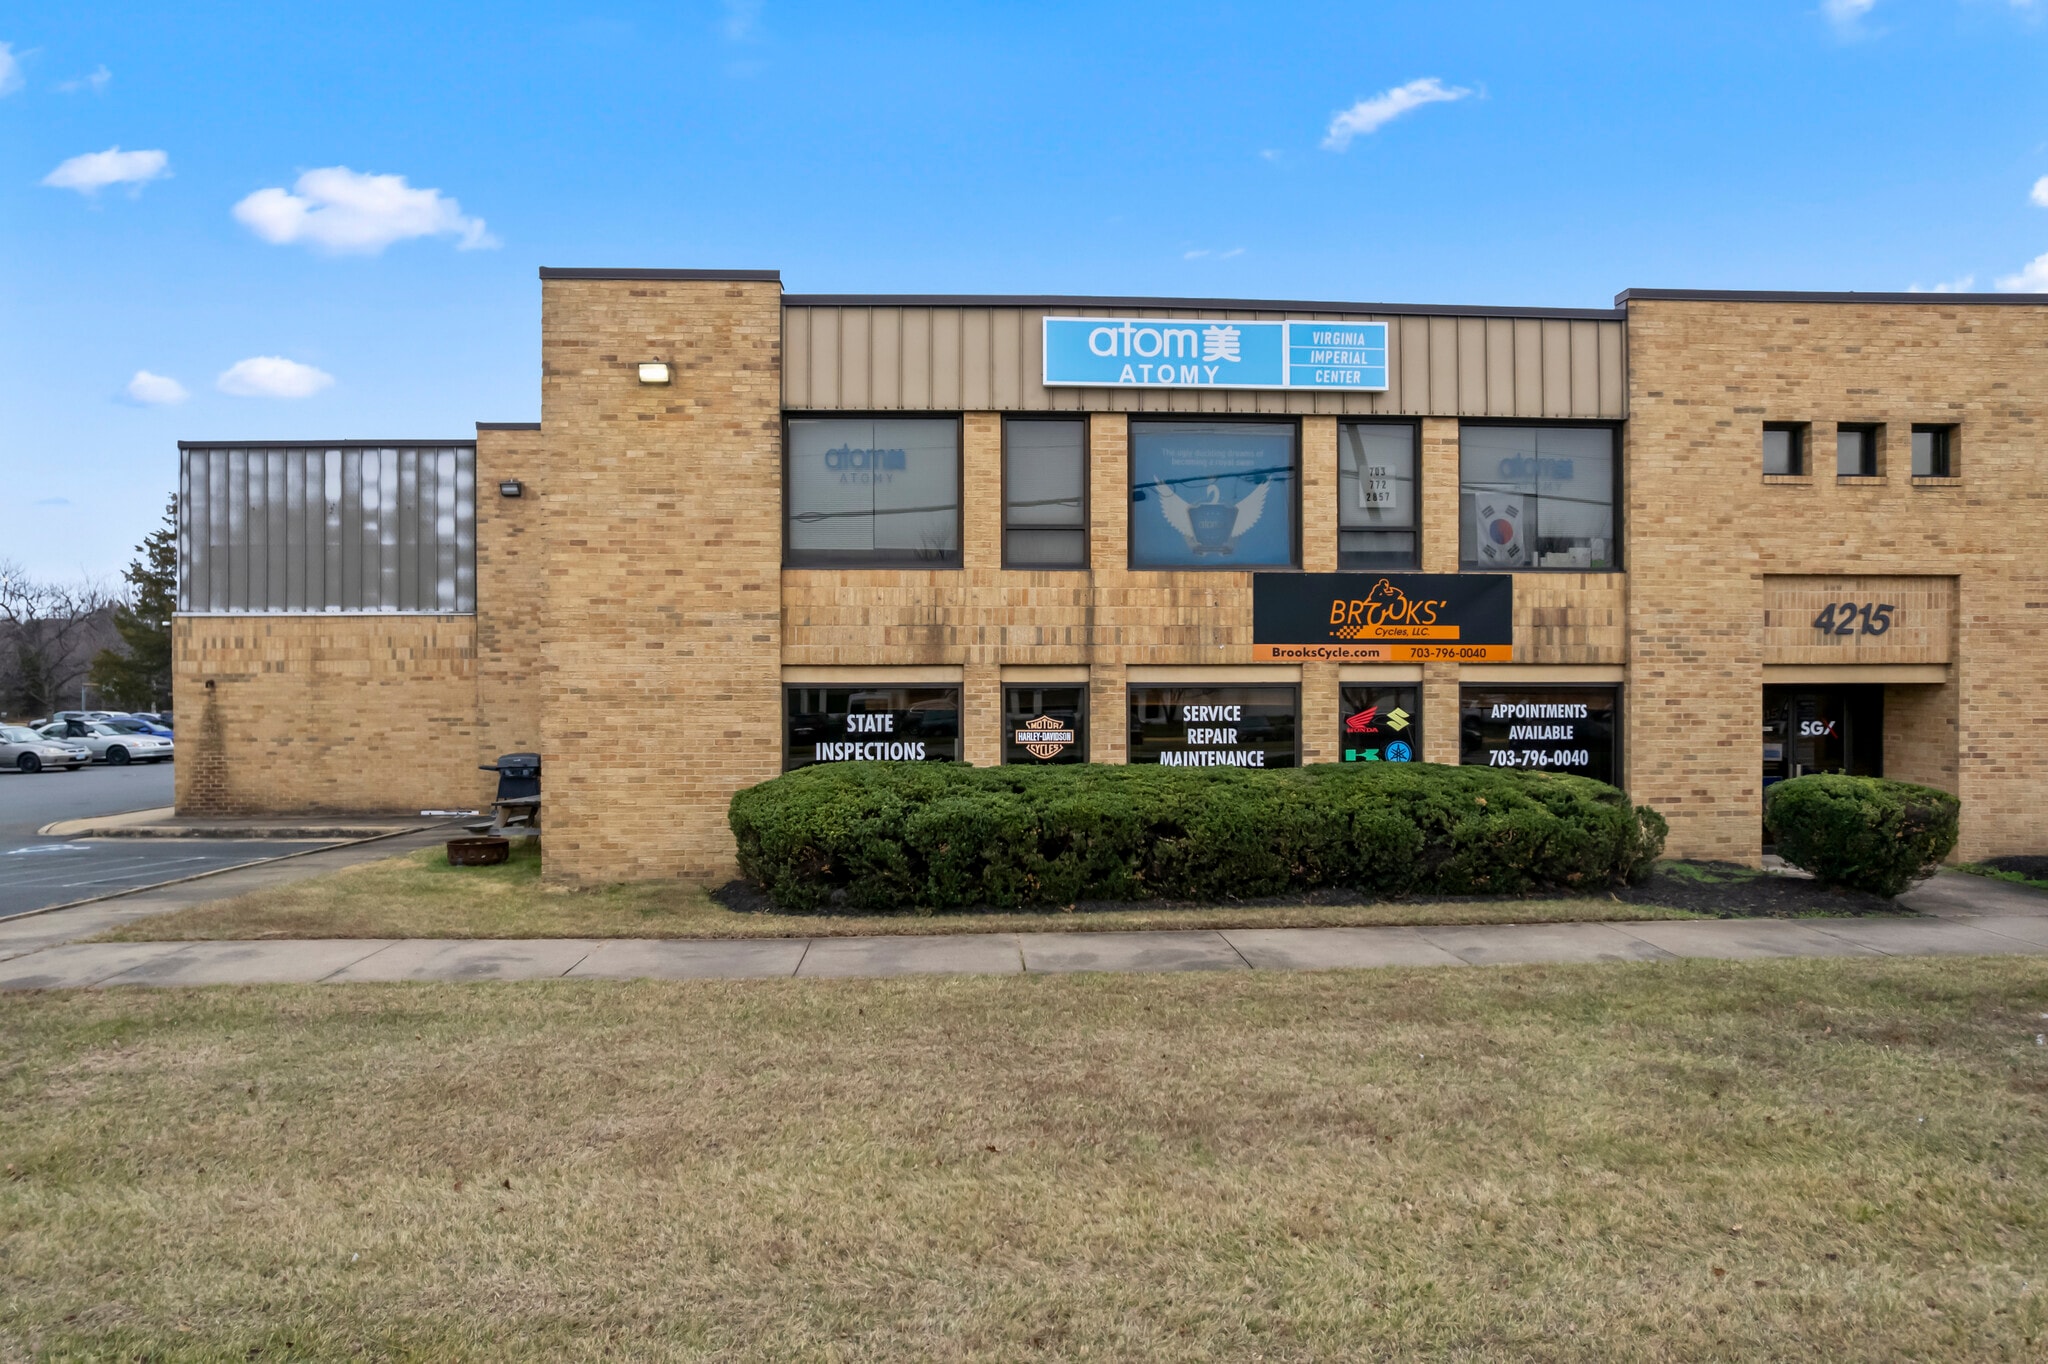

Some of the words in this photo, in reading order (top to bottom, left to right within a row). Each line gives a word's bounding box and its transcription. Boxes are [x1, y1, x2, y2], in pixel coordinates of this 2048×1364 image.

[1312, 331, 1366, 347] VIRGINIA
[1310, 350, 1369, 365] IMPERIAL
[1119, 364, 1220, 385] ATOMY
[1315, 369, 1361, 384] CENTER
[840, 473, 895, 484] ATOMY
[1369, 467, 1386, 477] 703
[1369, 480, 1387, 490] 772
[1366, 492, 1390, 502] 2857
[1813, 602, 1895, 636] 4215
[1375, 628, 1410, 638] Cycles,
[1412, 628, 1431, 637] LLC.
[1272, 647, 1380, 660] BrooksCycle.com
[1410, 647, 1487, 659] 703-796-0040
[1183, 705, 1241, 722] SERVICE
[1491, 704, 1588, 719] APPOINTMENTS
[847, 714, 894, 733] STATE
[1030, 718, 1060, 730] MOTOR
[1800, 717, 1839, 739] SGX
[1018, 732, 1072, 742] HARLEY-DAVIDSON
[1187, 728, 1238, 745] REPAIR
[1508, 725, 1574, 740] AVAILABLE
[815, 742, 926, 761] INSPECTIONS
[1030, 744, 1060, 756] CYCLES
[1160, 750, 1265, 768] MAINTENANCE
[1489, 750, 1589, 767] 703-796-0040
